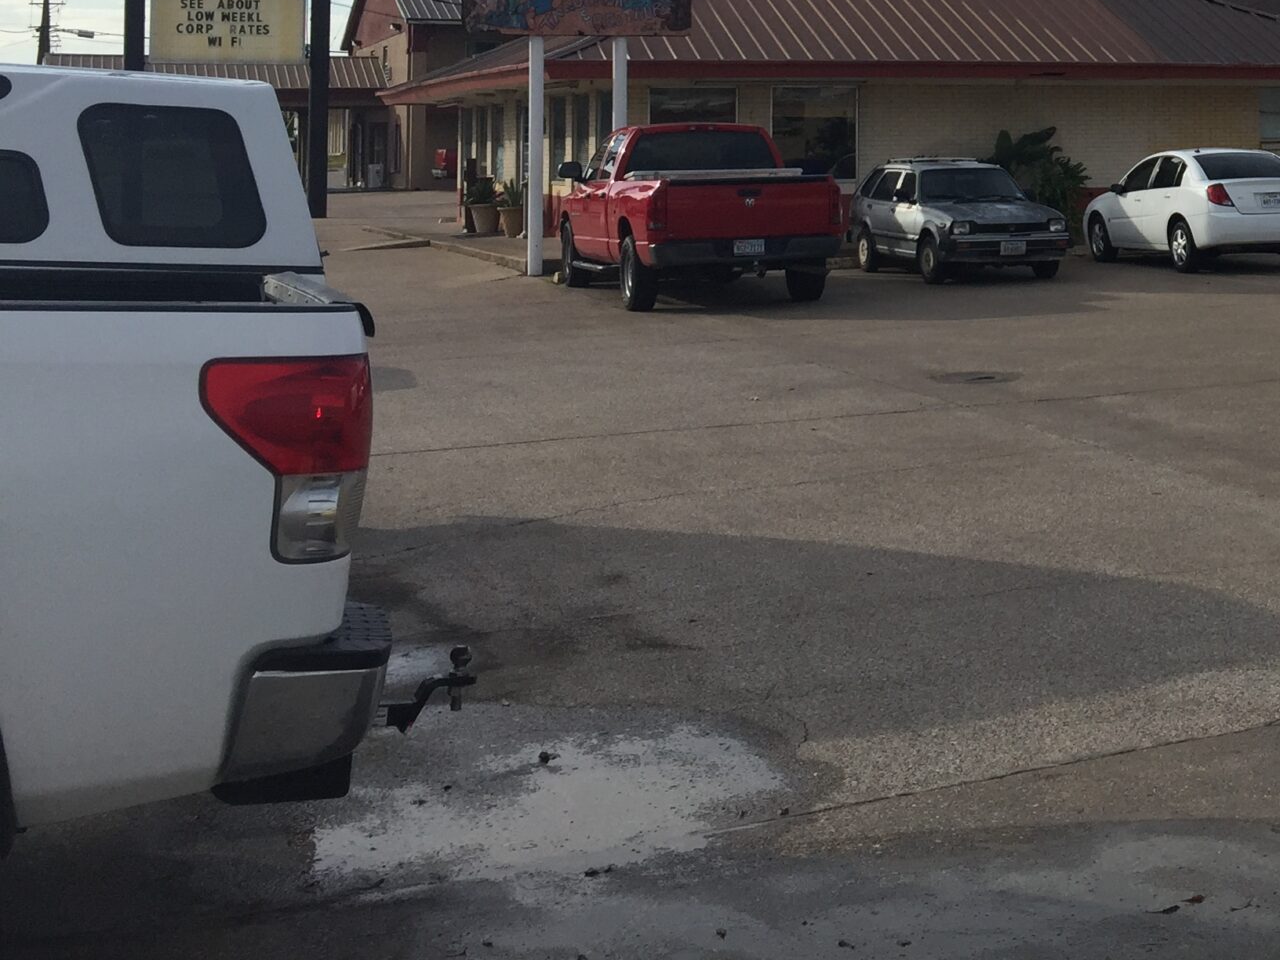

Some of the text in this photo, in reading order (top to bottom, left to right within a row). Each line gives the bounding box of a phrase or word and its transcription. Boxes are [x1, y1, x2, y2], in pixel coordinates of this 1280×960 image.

[217, 0, 261, 10] ABOUT
[187, 11, 263, 23] LOW WEEKL
[176, 23, 270, 36] CORP RATES
[207, 36, 222, 47] WI
